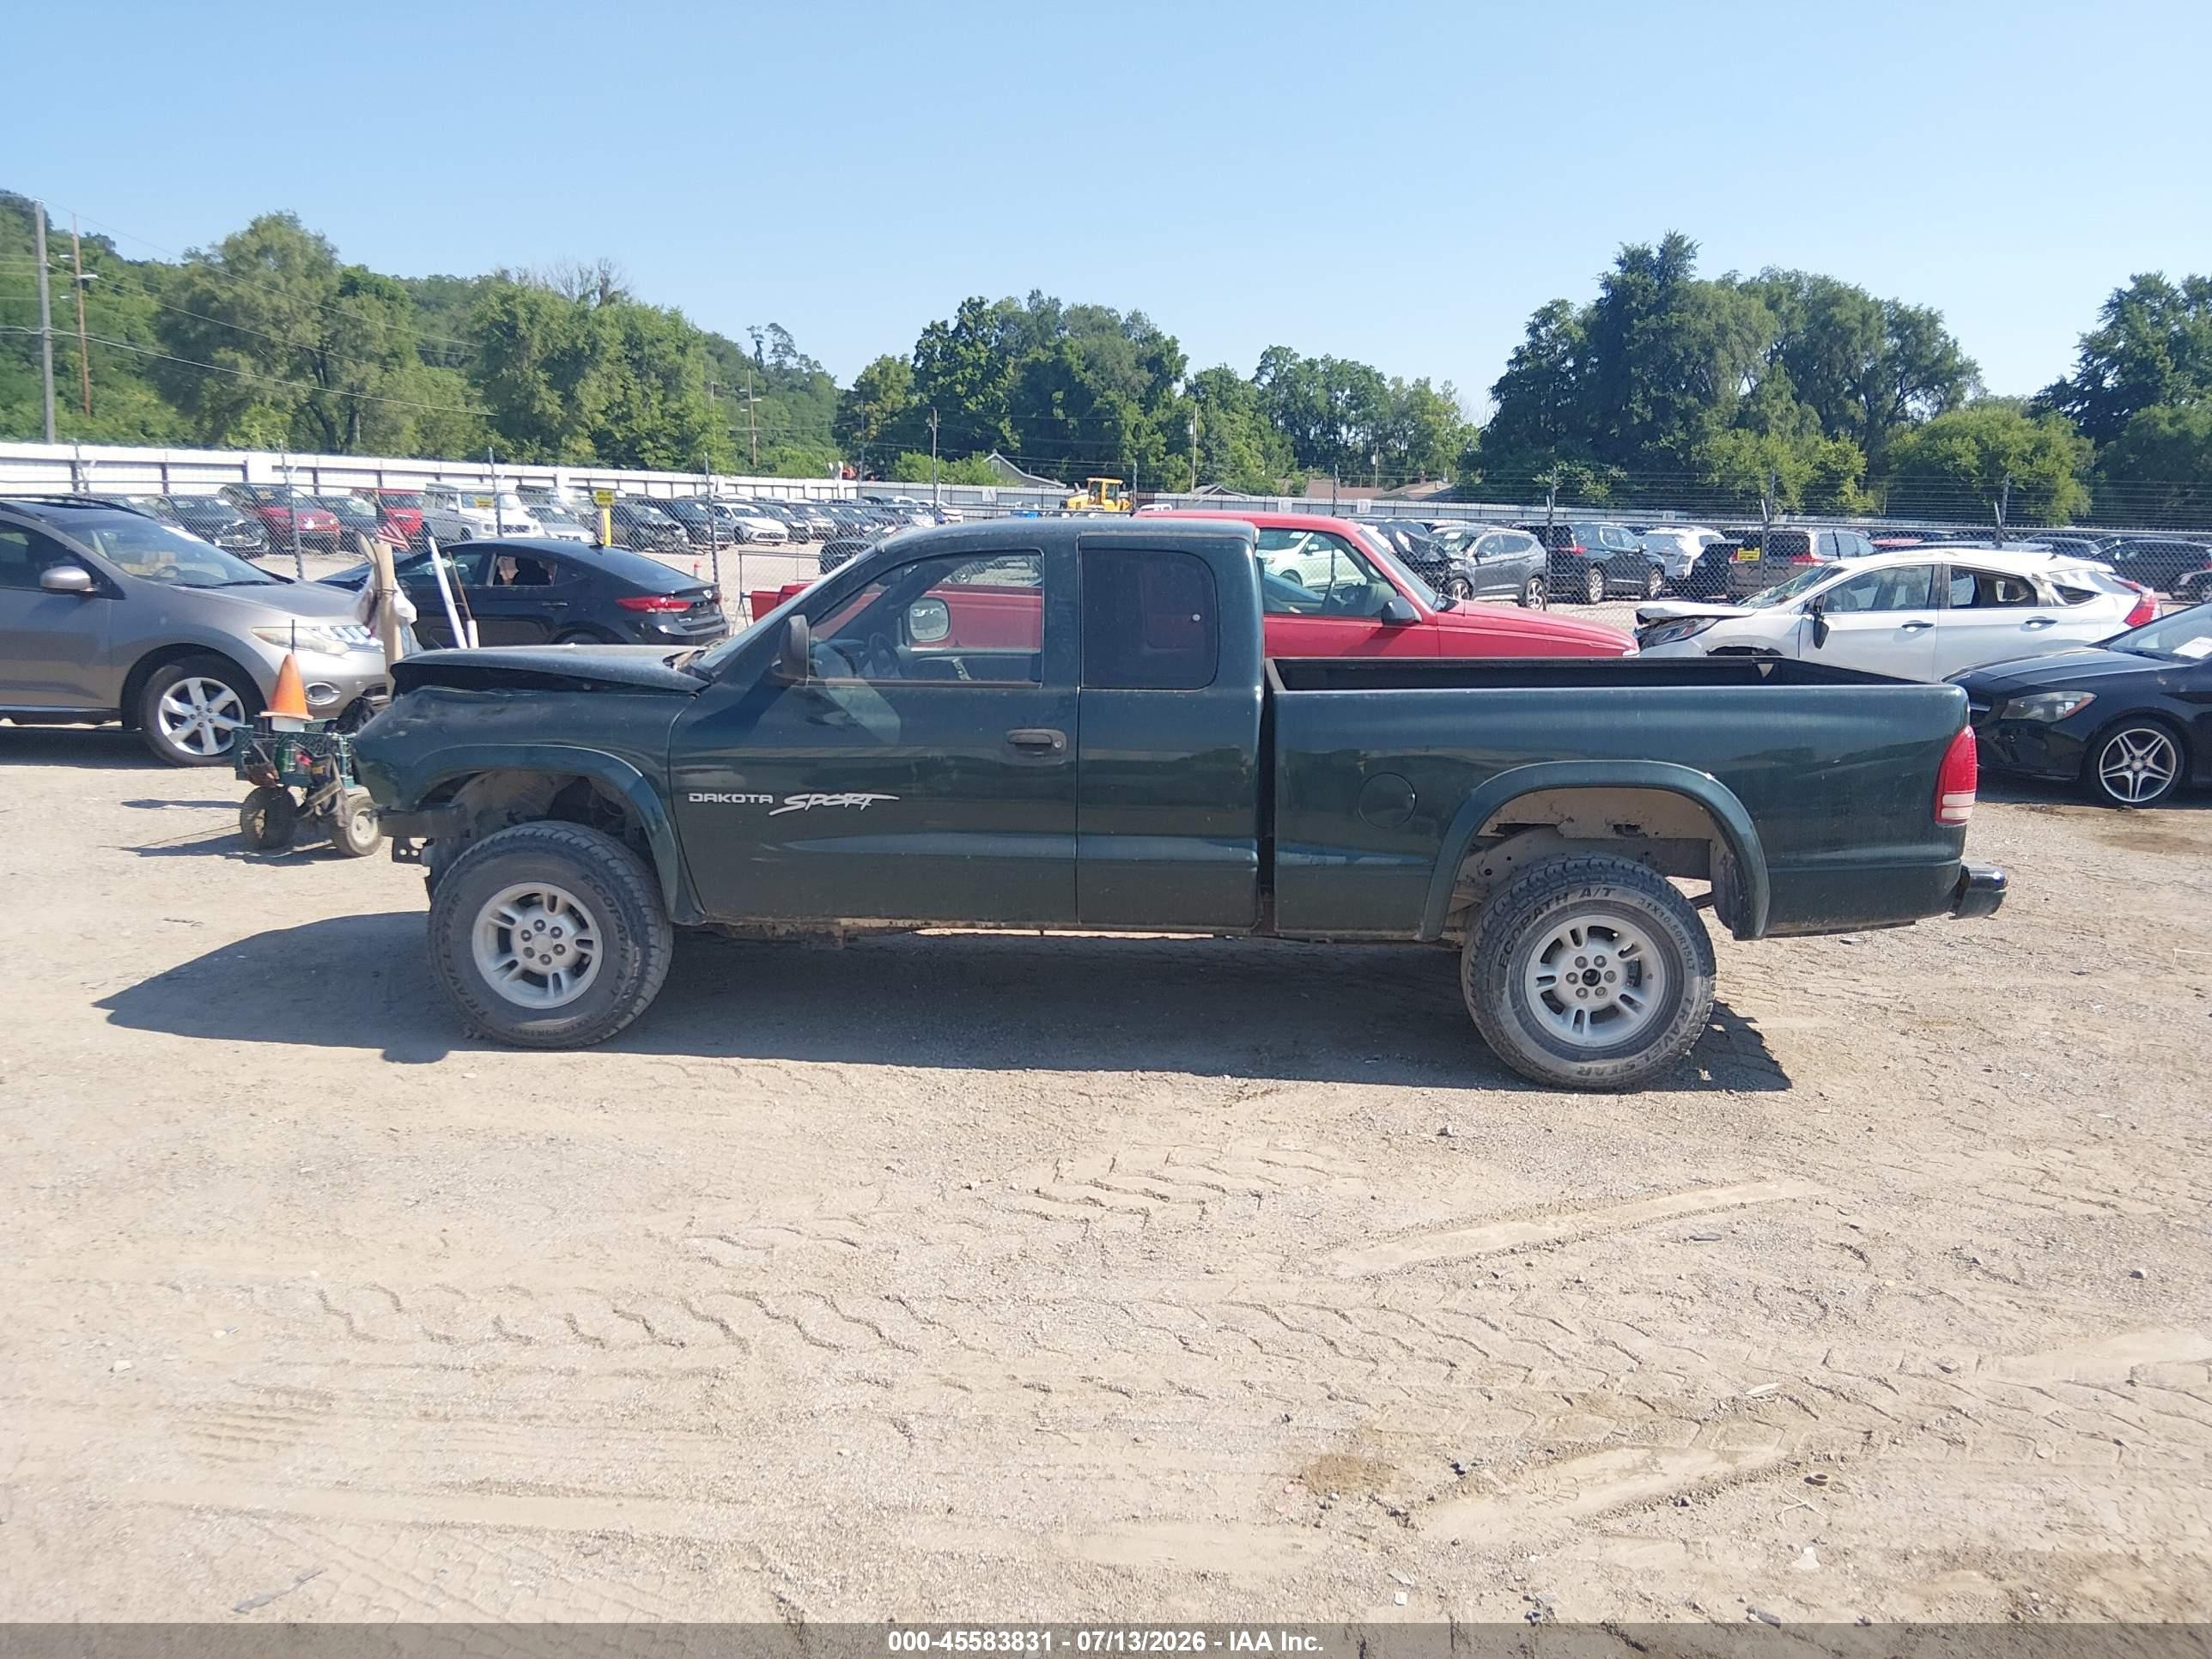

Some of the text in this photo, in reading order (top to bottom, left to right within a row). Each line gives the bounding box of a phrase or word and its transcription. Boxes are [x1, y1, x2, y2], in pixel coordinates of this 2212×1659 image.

[688, 792, 901, 817] DAKOTA SPORT
[1497, 886, 1617, 969] ECOPATH A/T
[1575, 995, 1695, 1078] TRAVELSTAR
